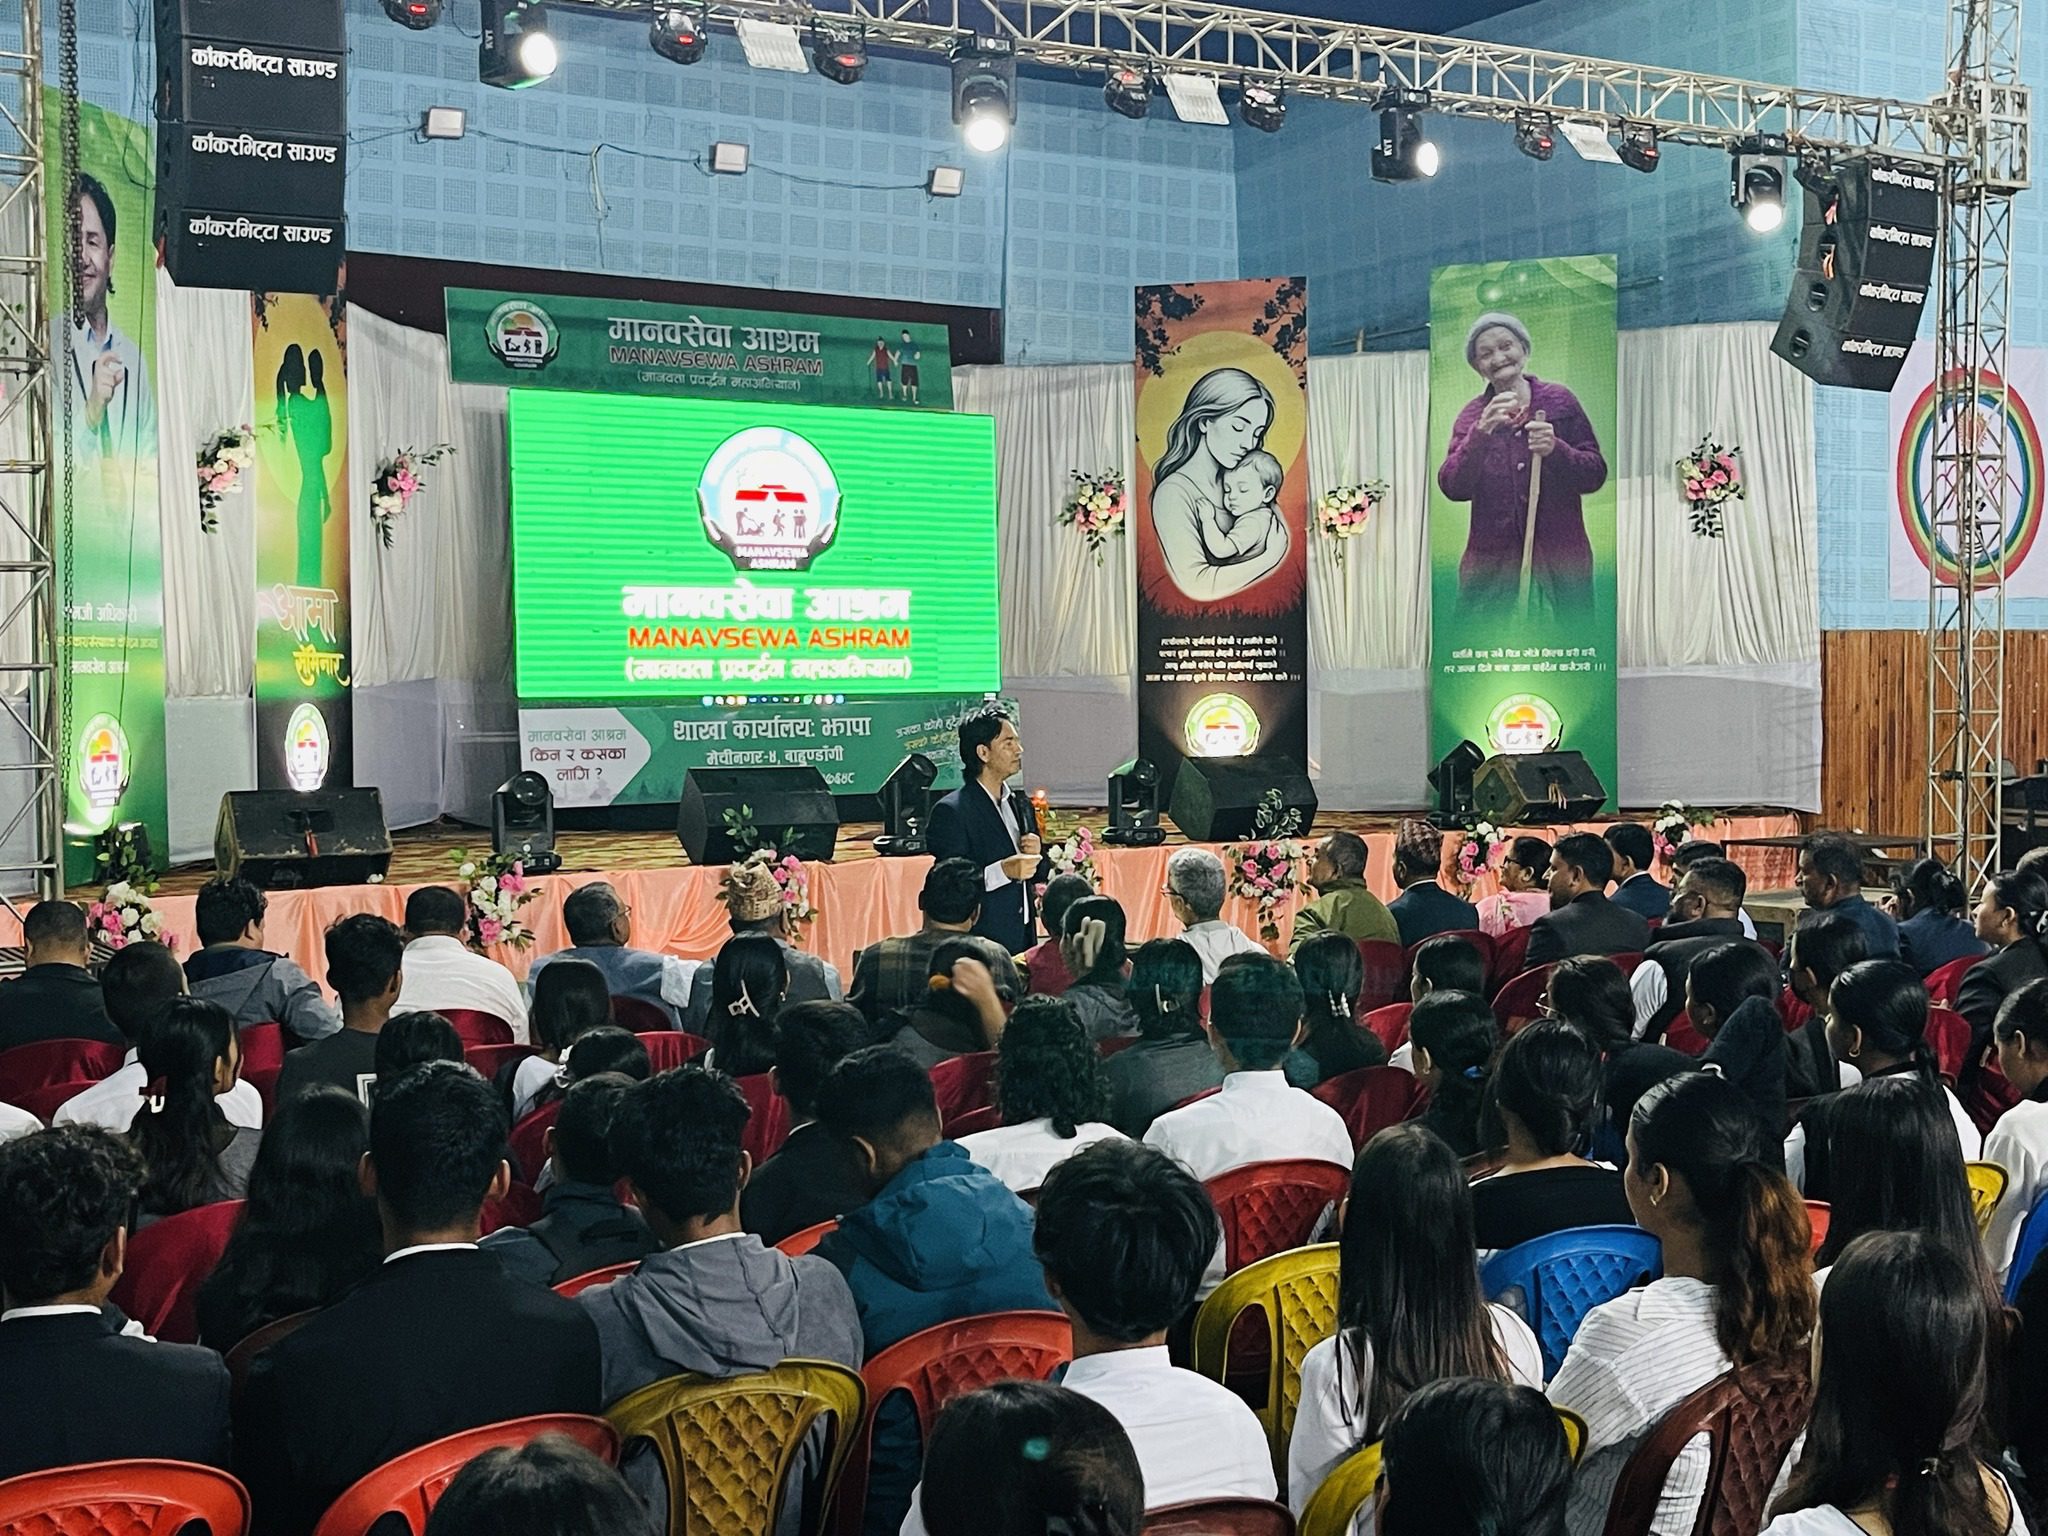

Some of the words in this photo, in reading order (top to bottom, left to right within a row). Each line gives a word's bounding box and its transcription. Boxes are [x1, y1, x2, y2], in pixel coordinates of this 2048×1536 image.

[287, 57, 338, 79] साउण्ड
[287, 143, 337, 163] साउण्ड
[283, 225, 333, 244] साउण्ड
[607, 315, 733, 349] मानवसेवा
[741, 326, 821, 354] आश्रम
[609, 346, 738, 372] MANAVSEWA
[743, 355, 823, 377] ASHRAM
[628, 627, 800, 649] MANAVSEWA
[808, 627, 911, 649] ASHRAM
[527, 726, 586, 743] मानवसेवा
[591, 729, 627, 741] आश्रम
[673, 719, 728, 741] शाखा
[732, 715, 816, 740] कार्यालय:
[821, 717, 872, 737] झापा
[529, 747, 561, 762] किन
[566, 748, 575, 761] र
[580, 747, 627, 761] कसका
[556, 765, 590, 781] लागि
[595, 767, 603, 780] ?
